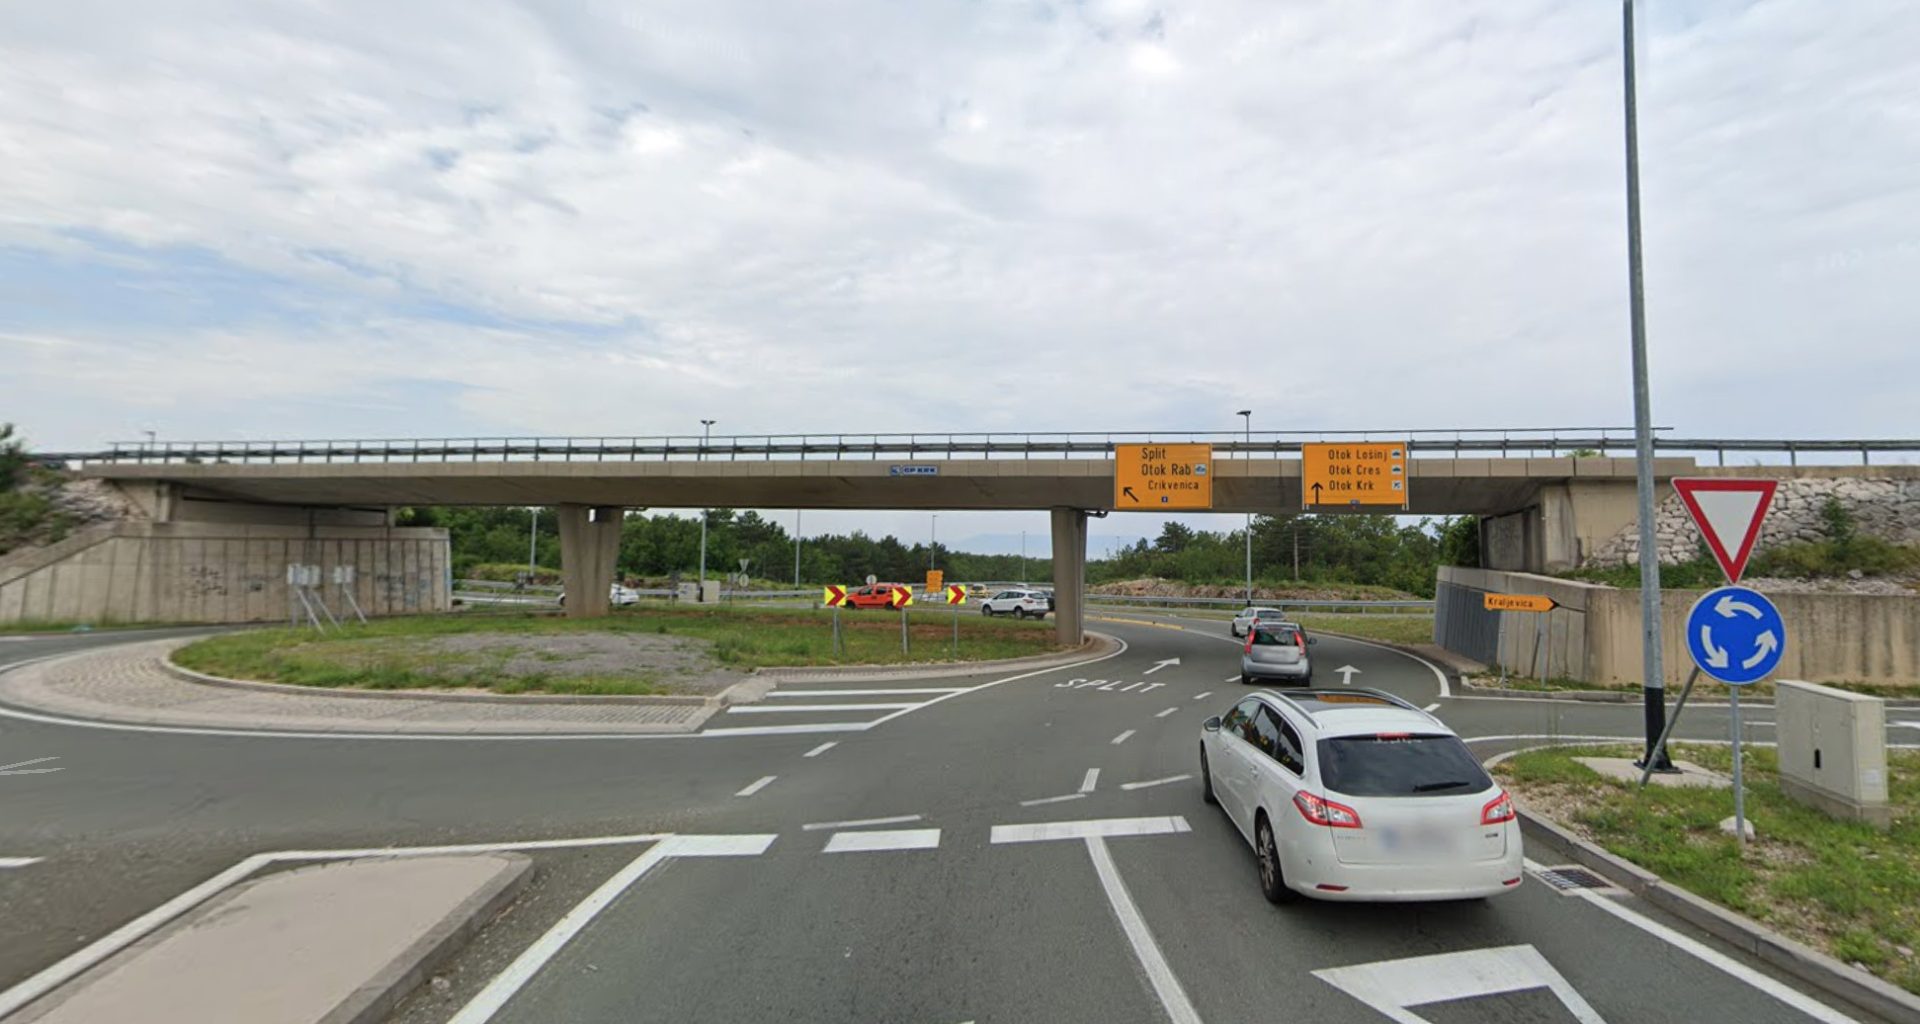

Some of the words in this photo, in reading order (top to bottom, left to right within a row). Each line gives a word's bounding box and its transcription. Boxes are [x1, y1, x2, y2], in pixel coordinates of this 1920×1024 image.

[1142, 447, 1166, 461] Split
[1328, 449, 1352, 460] Otok
[1141, 463, 1167, 476] Otok
[1171, 463, 1192, 476] Rab
[1328, 464, 1352, 475] Otok
[1356, 464, 1381, 475] Cres
[1148, 480, 1199, 490] Crikvenica
[1328, 480, 1352, 491] Otok
[1356, 480, 1375, 491] Krk
[1488, 598, 1533, 609] Kraljevica
[1053, 678, 1167, 693] SPLIT
